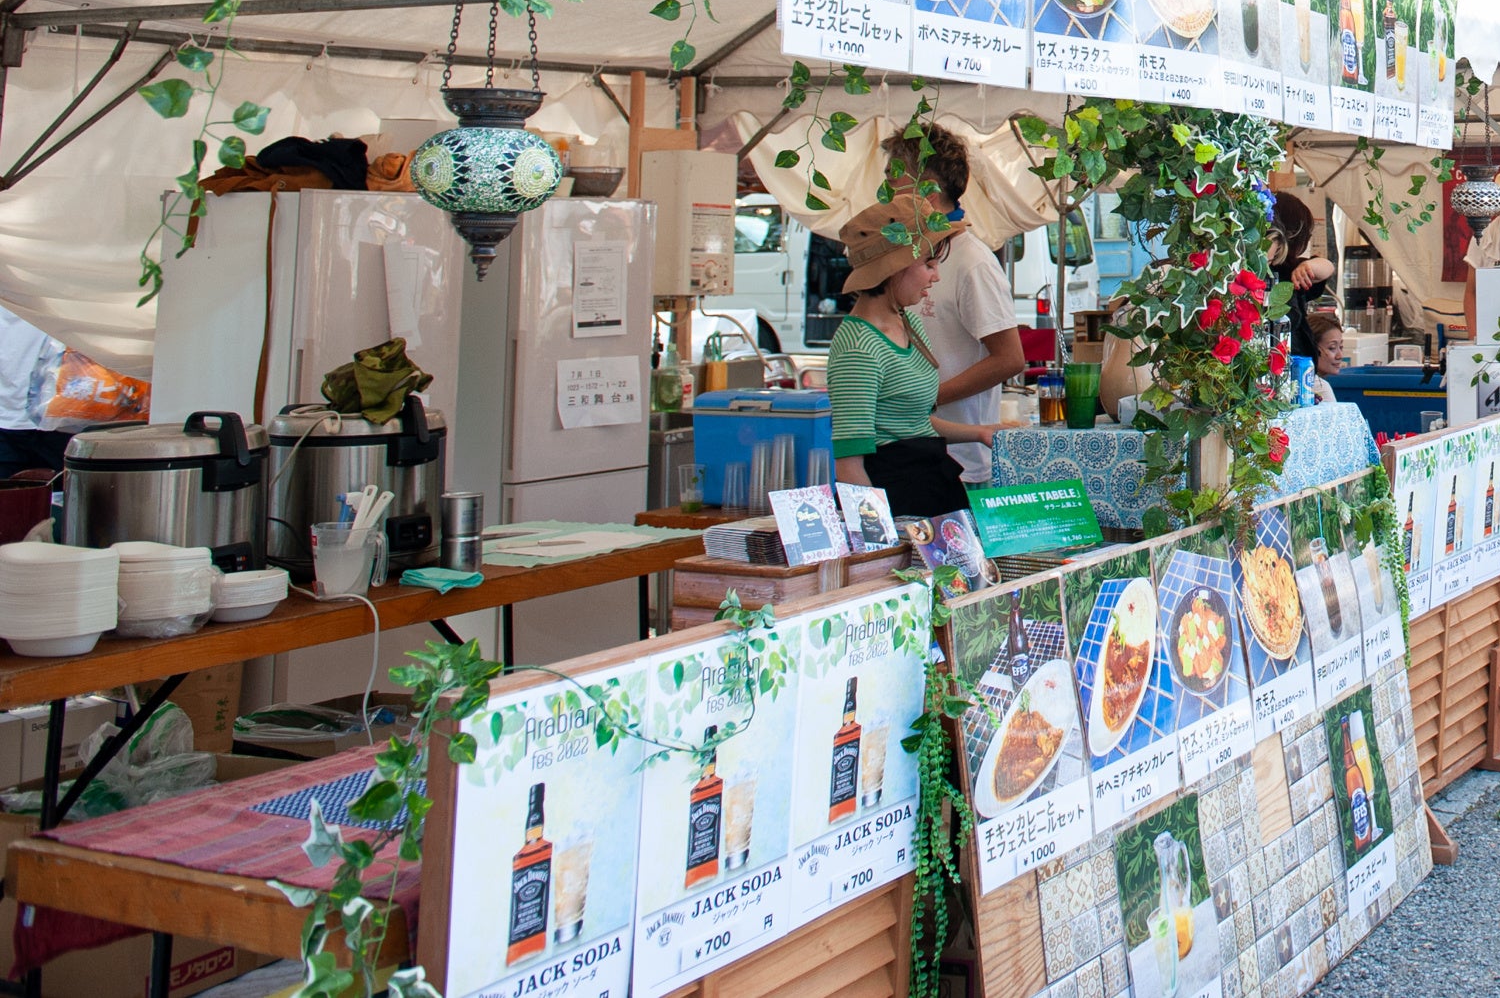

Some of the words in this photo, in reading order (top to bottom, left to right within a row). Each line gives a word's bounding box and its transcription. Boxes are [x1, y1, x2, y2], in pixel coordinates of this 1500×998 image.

[791, 10, 903, 41] エフェスビールセット
[829, 41, 865, 57] ¥1000
[918, 24, 1021, 53] ボヘミアチキンカレー
[957, 57, 981, 71] ¥700
[1037, 40, 1112, 64] ヤズ・サラタス
[1139, 53, 1167, 71] ホモス
[1074, 78, 1098, 90] ¥500
[1171, 89, 1191, 101] ¥400
[1286, 85, 1301, 100] チャイ
[845, 611, 895, 655] Arabian
[1366, 634, 1378, 649] チャイ
[850, 648, 863, 667] fes
[866, 641, 889, 662] 2022
[1012, 664, 1028, 677] EFES
[706, 695, 724, 714] fes
[1255, 689, 1276, 710] ホモス
[525, 701, 598, 757] Arabian
[1280, 709, 1295, 726] ¥400
[531, 746, 552, 771] fes
[557, 735, 589, 760] 2022
[1215, 747, 1232, 765] ¥500
[1096, 749, 1174, 798] ボヘミアチキンカレー
[1131, 784, 1152, 803] ¥700
[985, 801, 1055, 845] チキンカレーと
[1354, 802, 1368, 824] EFES
[834, 820, 871, 851] JACK
[875, 804, 912, 833] SODA
[986, 804, 1085, 863] エフェスビールセット
[851, 838, 874, 857] ジャック
[876, 828, 896, 845] ソーダ
[1023, 842, 1056, 866] ¥1000
[896, 848, 905, 863] 円
[843, 868, 874, 892] ¥700
[1349, 851, 1388, 893] エフェスビール
[691, 885, 737, 918] JACK
[741, 865, 782, 897] SODA
[712, 905, 739, 924] ジャック
[742, 893, 763, 910] ソーダ
[764, 914, 772, 930] 円
[695, 931, 731, 959] ¥700
[513, 961, 567, 998] JACK
[572, 937, 622, 971] SODA
[573, 968, 598, 987] ソーダ
